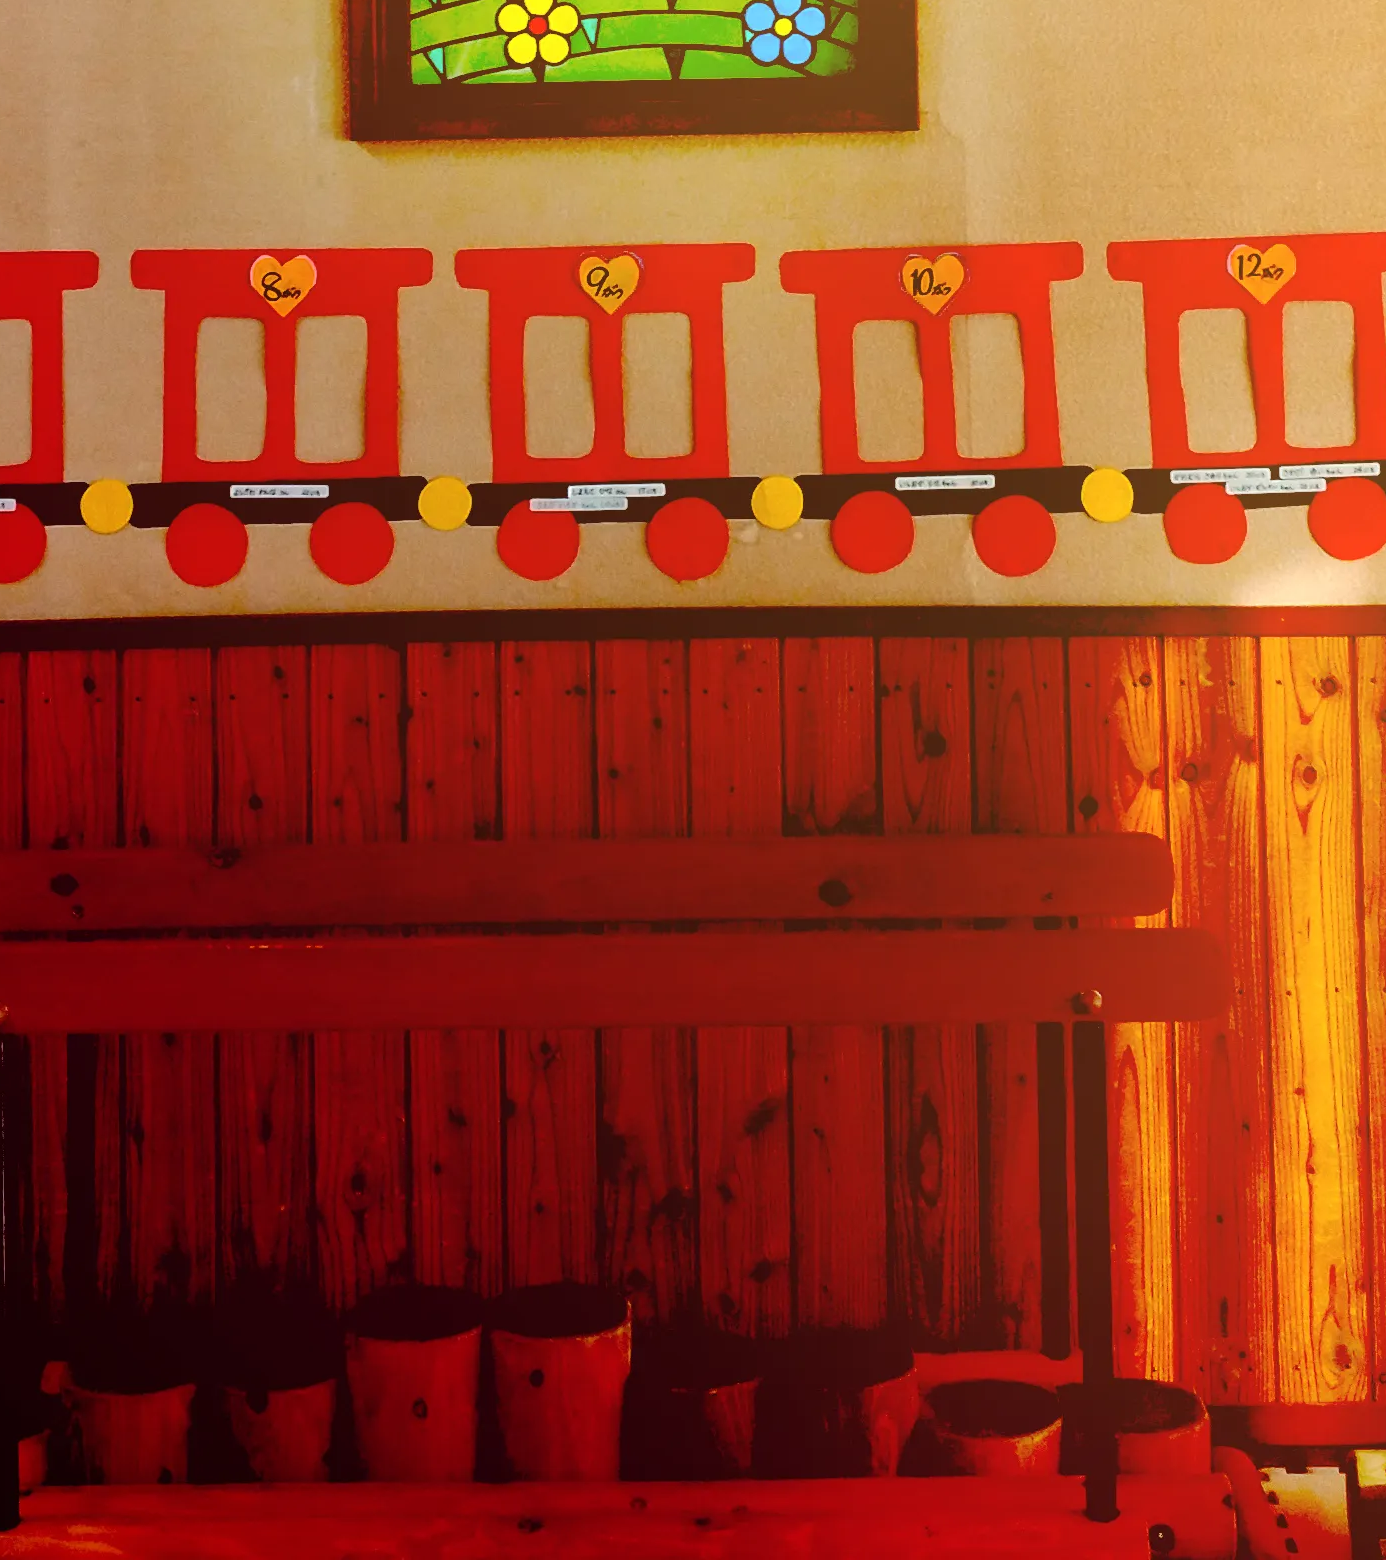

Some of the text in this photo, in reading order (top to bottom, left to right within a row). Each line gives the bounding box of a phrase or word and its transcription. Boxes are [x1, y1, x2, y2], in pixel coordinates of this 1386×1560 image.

[909, 267, 952, 297] 10がつ
[1236, 253, 1284, 281] 12がつ
[261, 270, 302, 302] 8がつ
[586, 266, 624, 300] 9がつ
